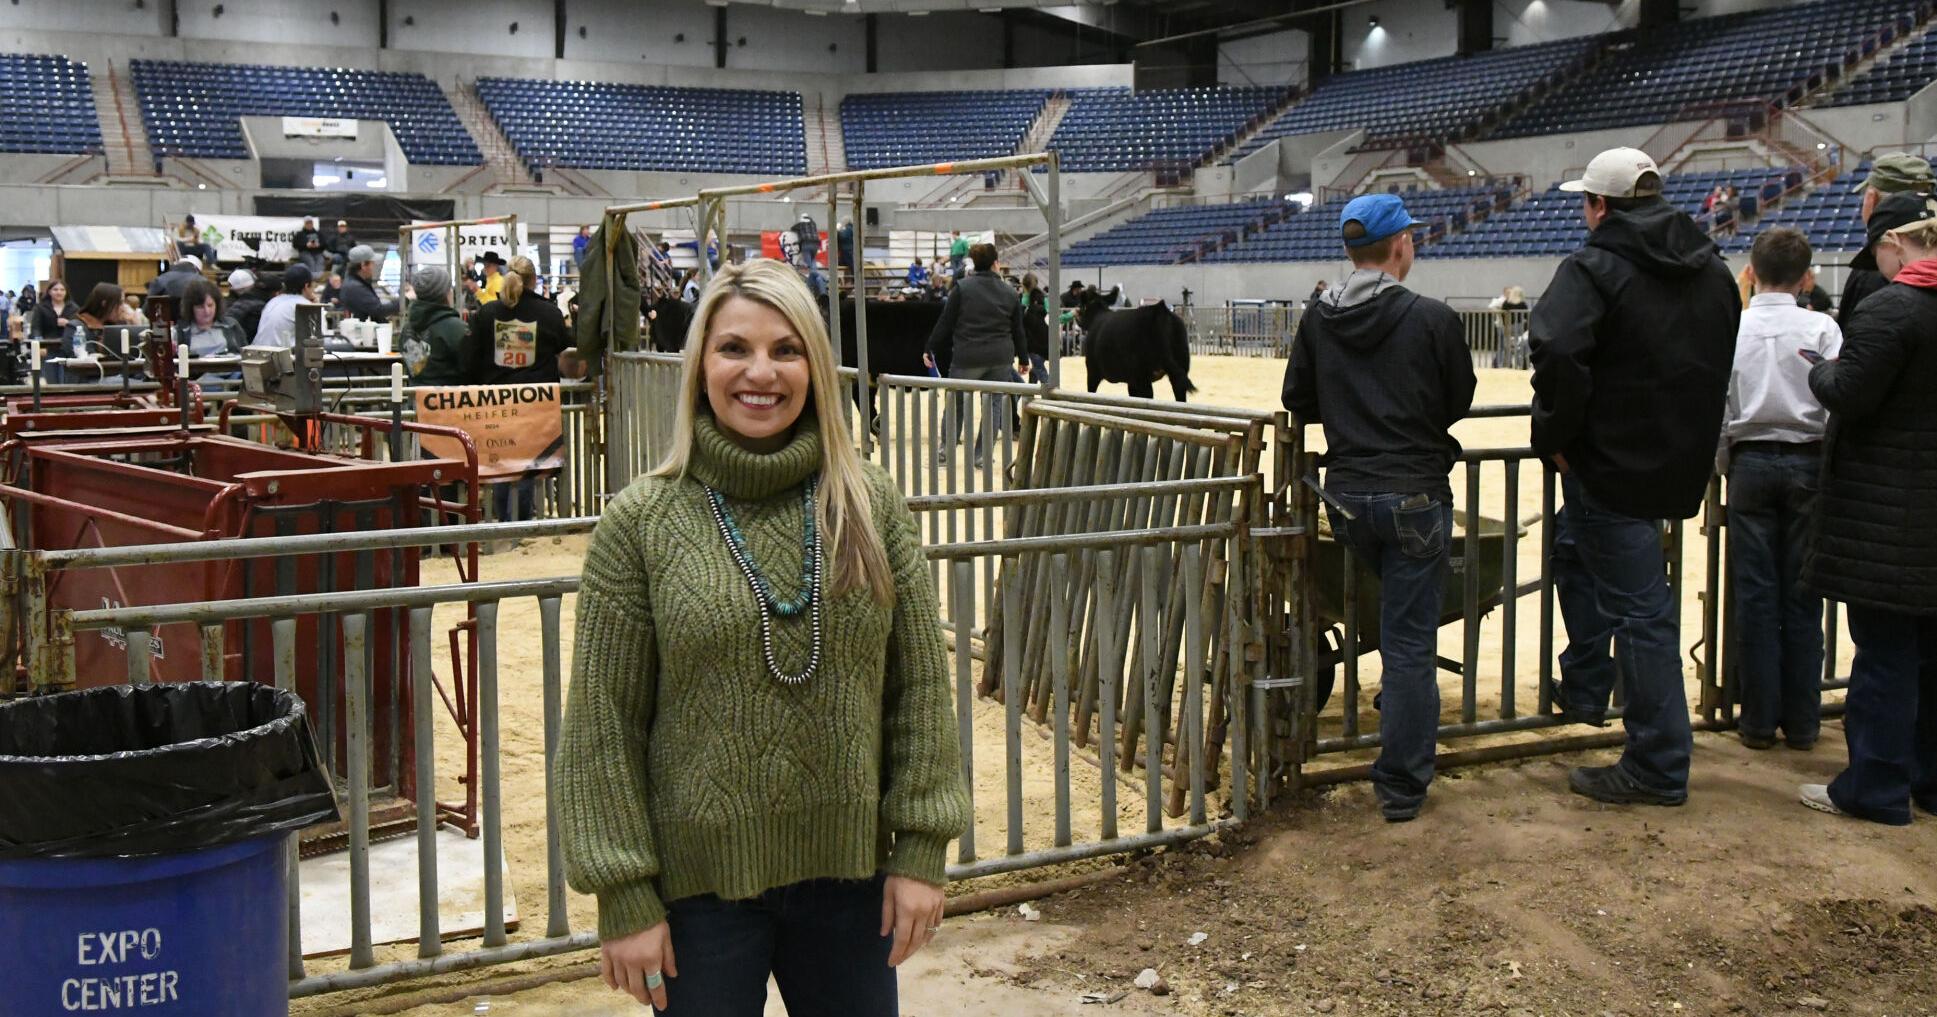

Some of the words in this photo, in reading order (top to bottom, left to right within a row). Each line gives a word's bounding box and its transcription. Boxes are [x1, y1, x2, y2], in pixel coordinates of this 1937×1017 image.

[231, 229, 261, 241] Farm
[266, 230, 298, 242] Cred
[503, 351, 527, 366] 20
[423, 386, 554, 411] CHAMPION
[463, 408, 518, 420] HEIFER
[78, 927, 161, 965] EXPO
[61, 970, 179, 1011] CENTER
